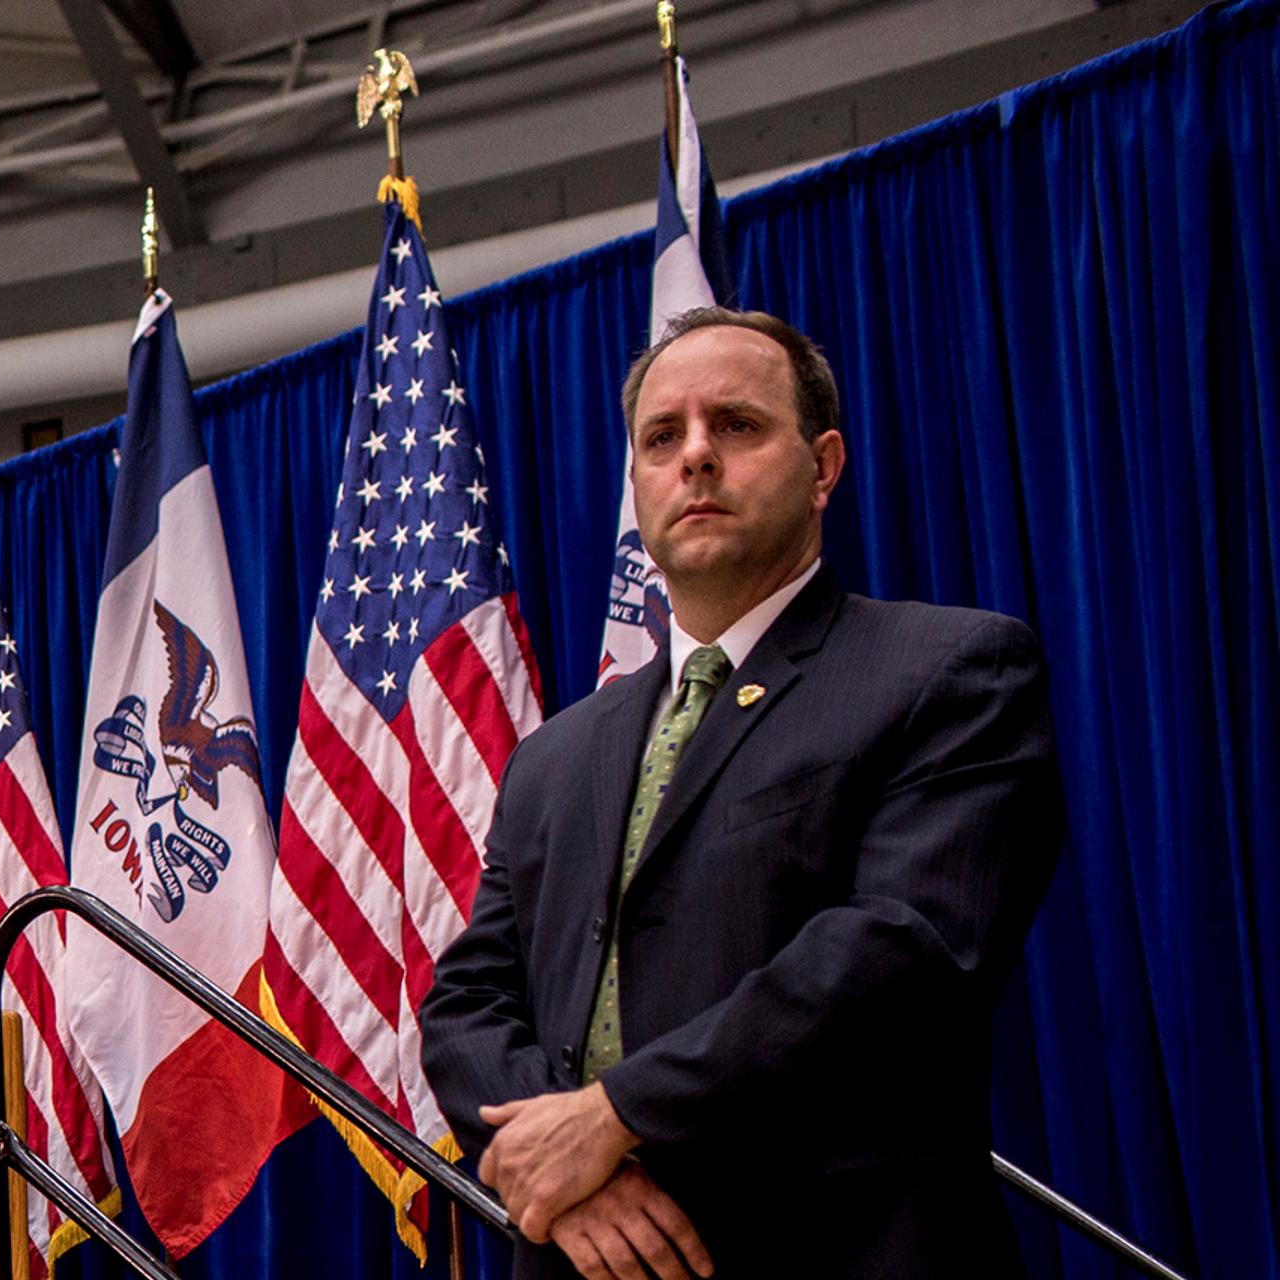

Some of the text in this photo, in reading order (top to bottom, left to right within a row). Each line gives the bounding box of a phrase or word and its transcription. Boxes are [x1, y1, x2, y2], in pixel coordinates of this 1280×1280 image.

[610, 602, 633, 621] WE
[111, 758, 131, 774] WE
[180, 818, 225, 855] RIGHTS
[151, 839, 181, 900] MAINTAIN
[171, 839, 213, 884] WE WILL
